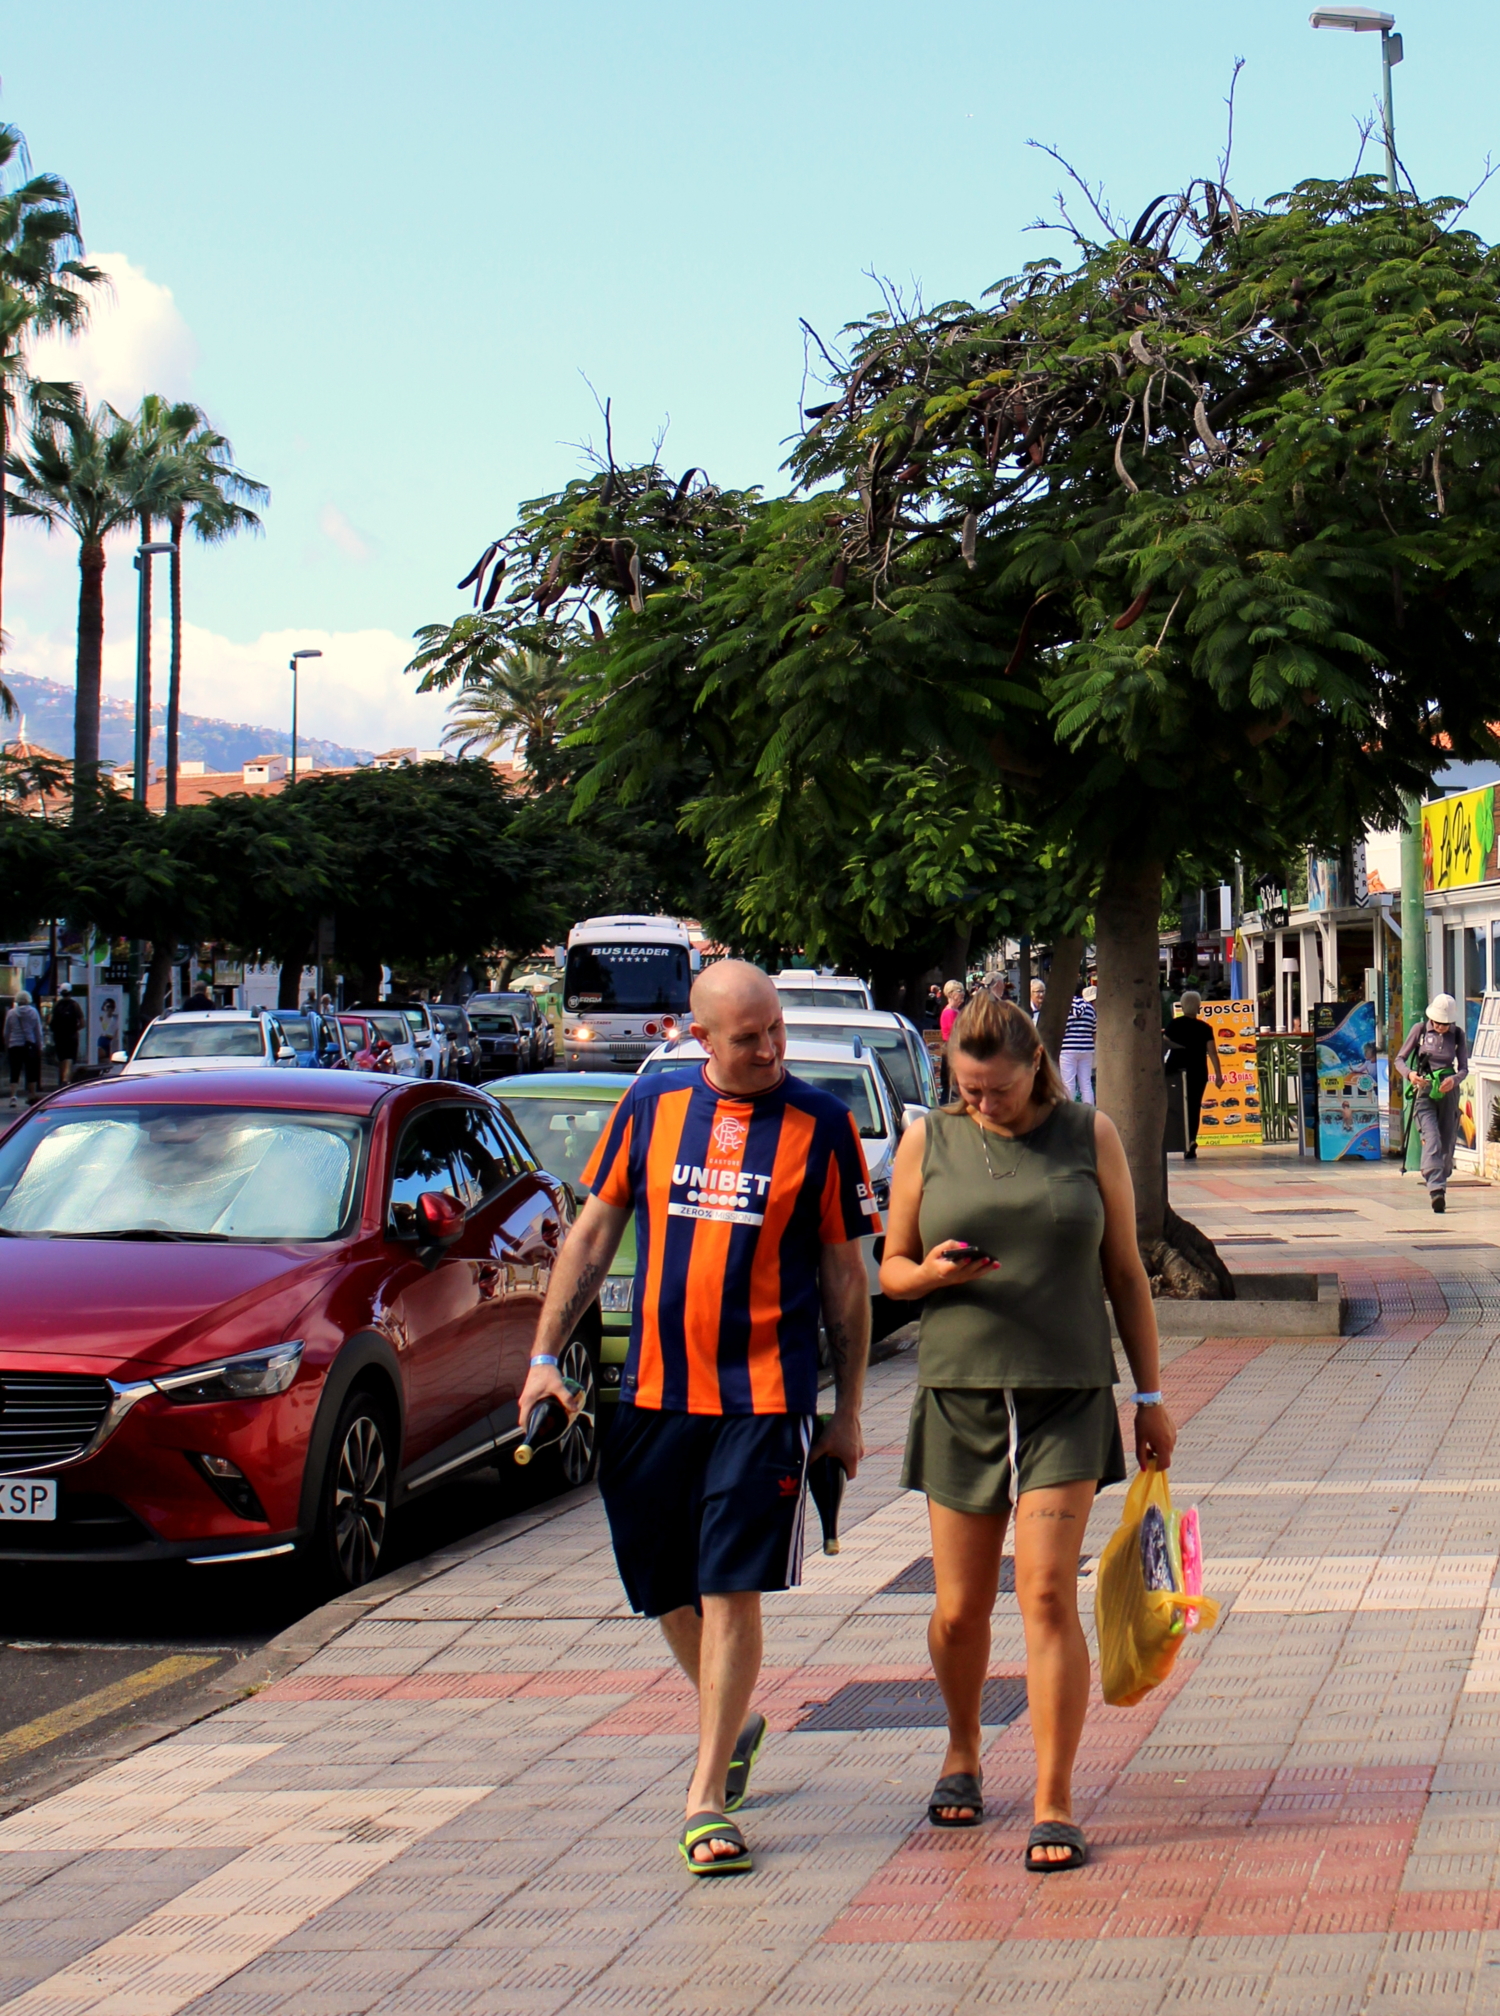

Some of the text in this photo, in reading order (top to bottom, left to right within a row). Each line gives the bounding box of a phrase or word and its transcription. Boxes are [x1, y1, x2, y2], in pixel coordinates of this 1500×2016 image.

[1438, 815, 1452, 887] La
[591, 947, 670, 956] BUS LEADER
[1198, 1002, 1255, 1017] rgosCa
[1229, 1070, 1238, 1084] 3
[672, 1164, 772, 1196] UNIBET
[680, 1206, 712, 1218] ZERO%
